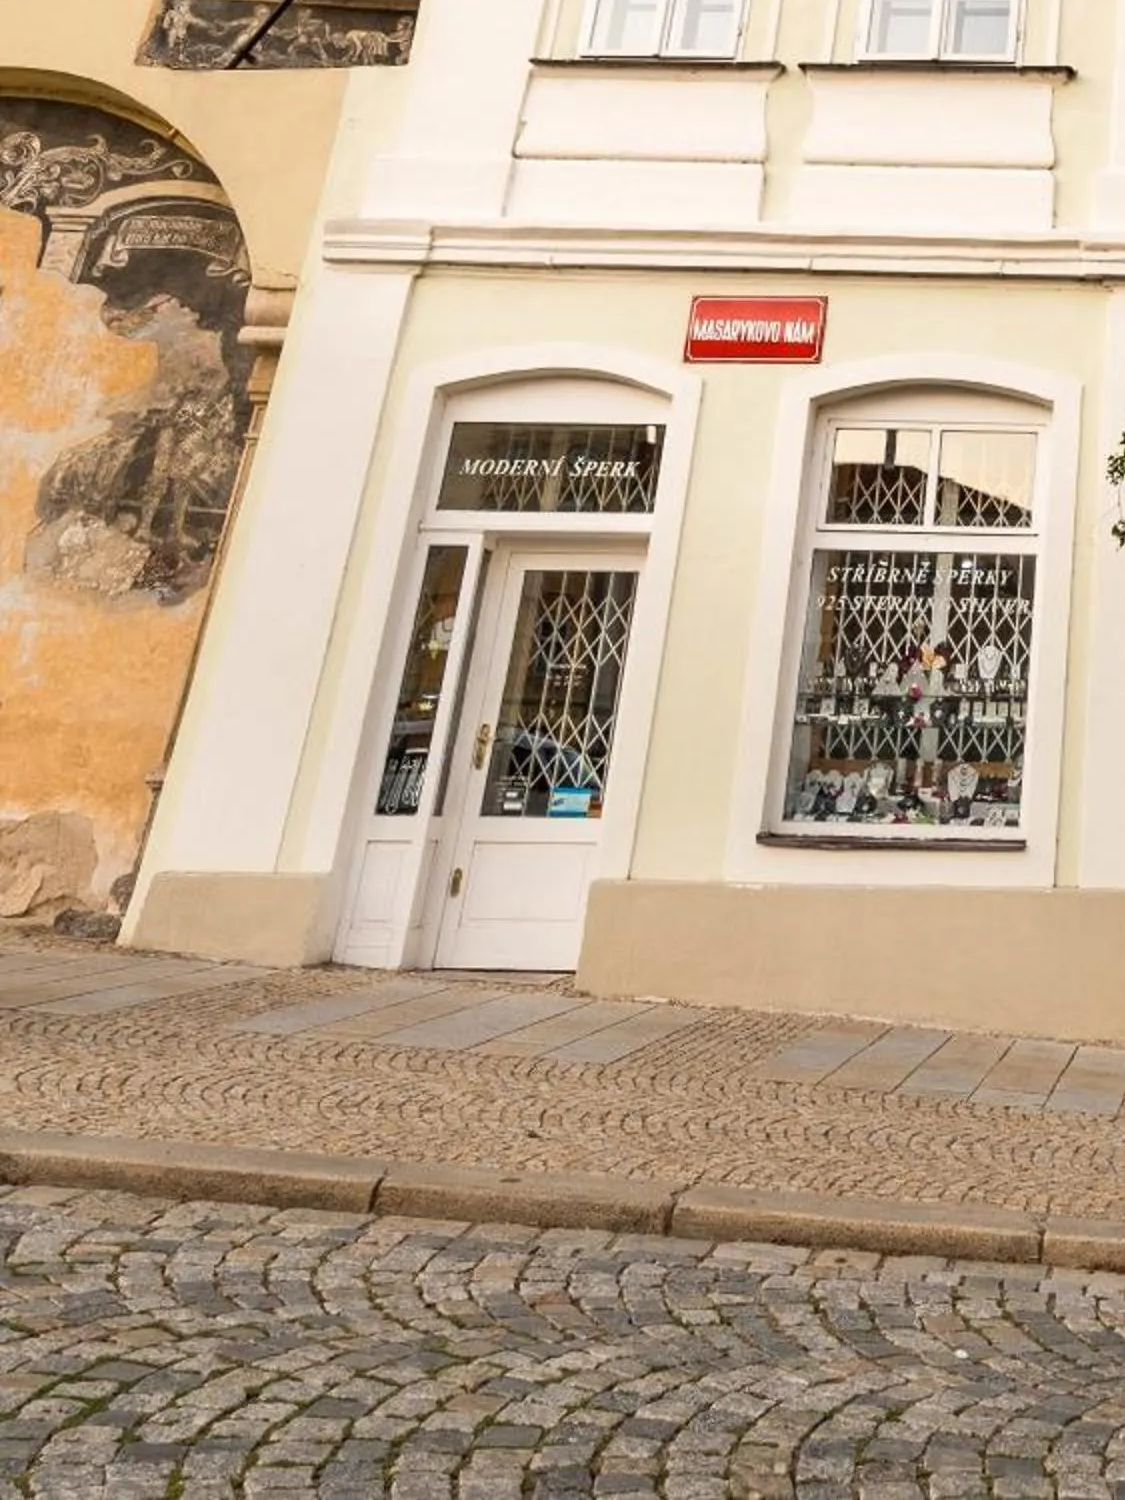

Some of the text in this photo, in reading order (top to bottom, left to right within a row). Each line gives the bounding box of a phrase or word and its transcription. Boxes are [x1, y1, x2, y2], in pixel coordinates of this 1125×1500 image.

[694, 319, 781, 343] MASARYKOVO
[459, 455, 640, 477] MODERNÍ ŠPERK
